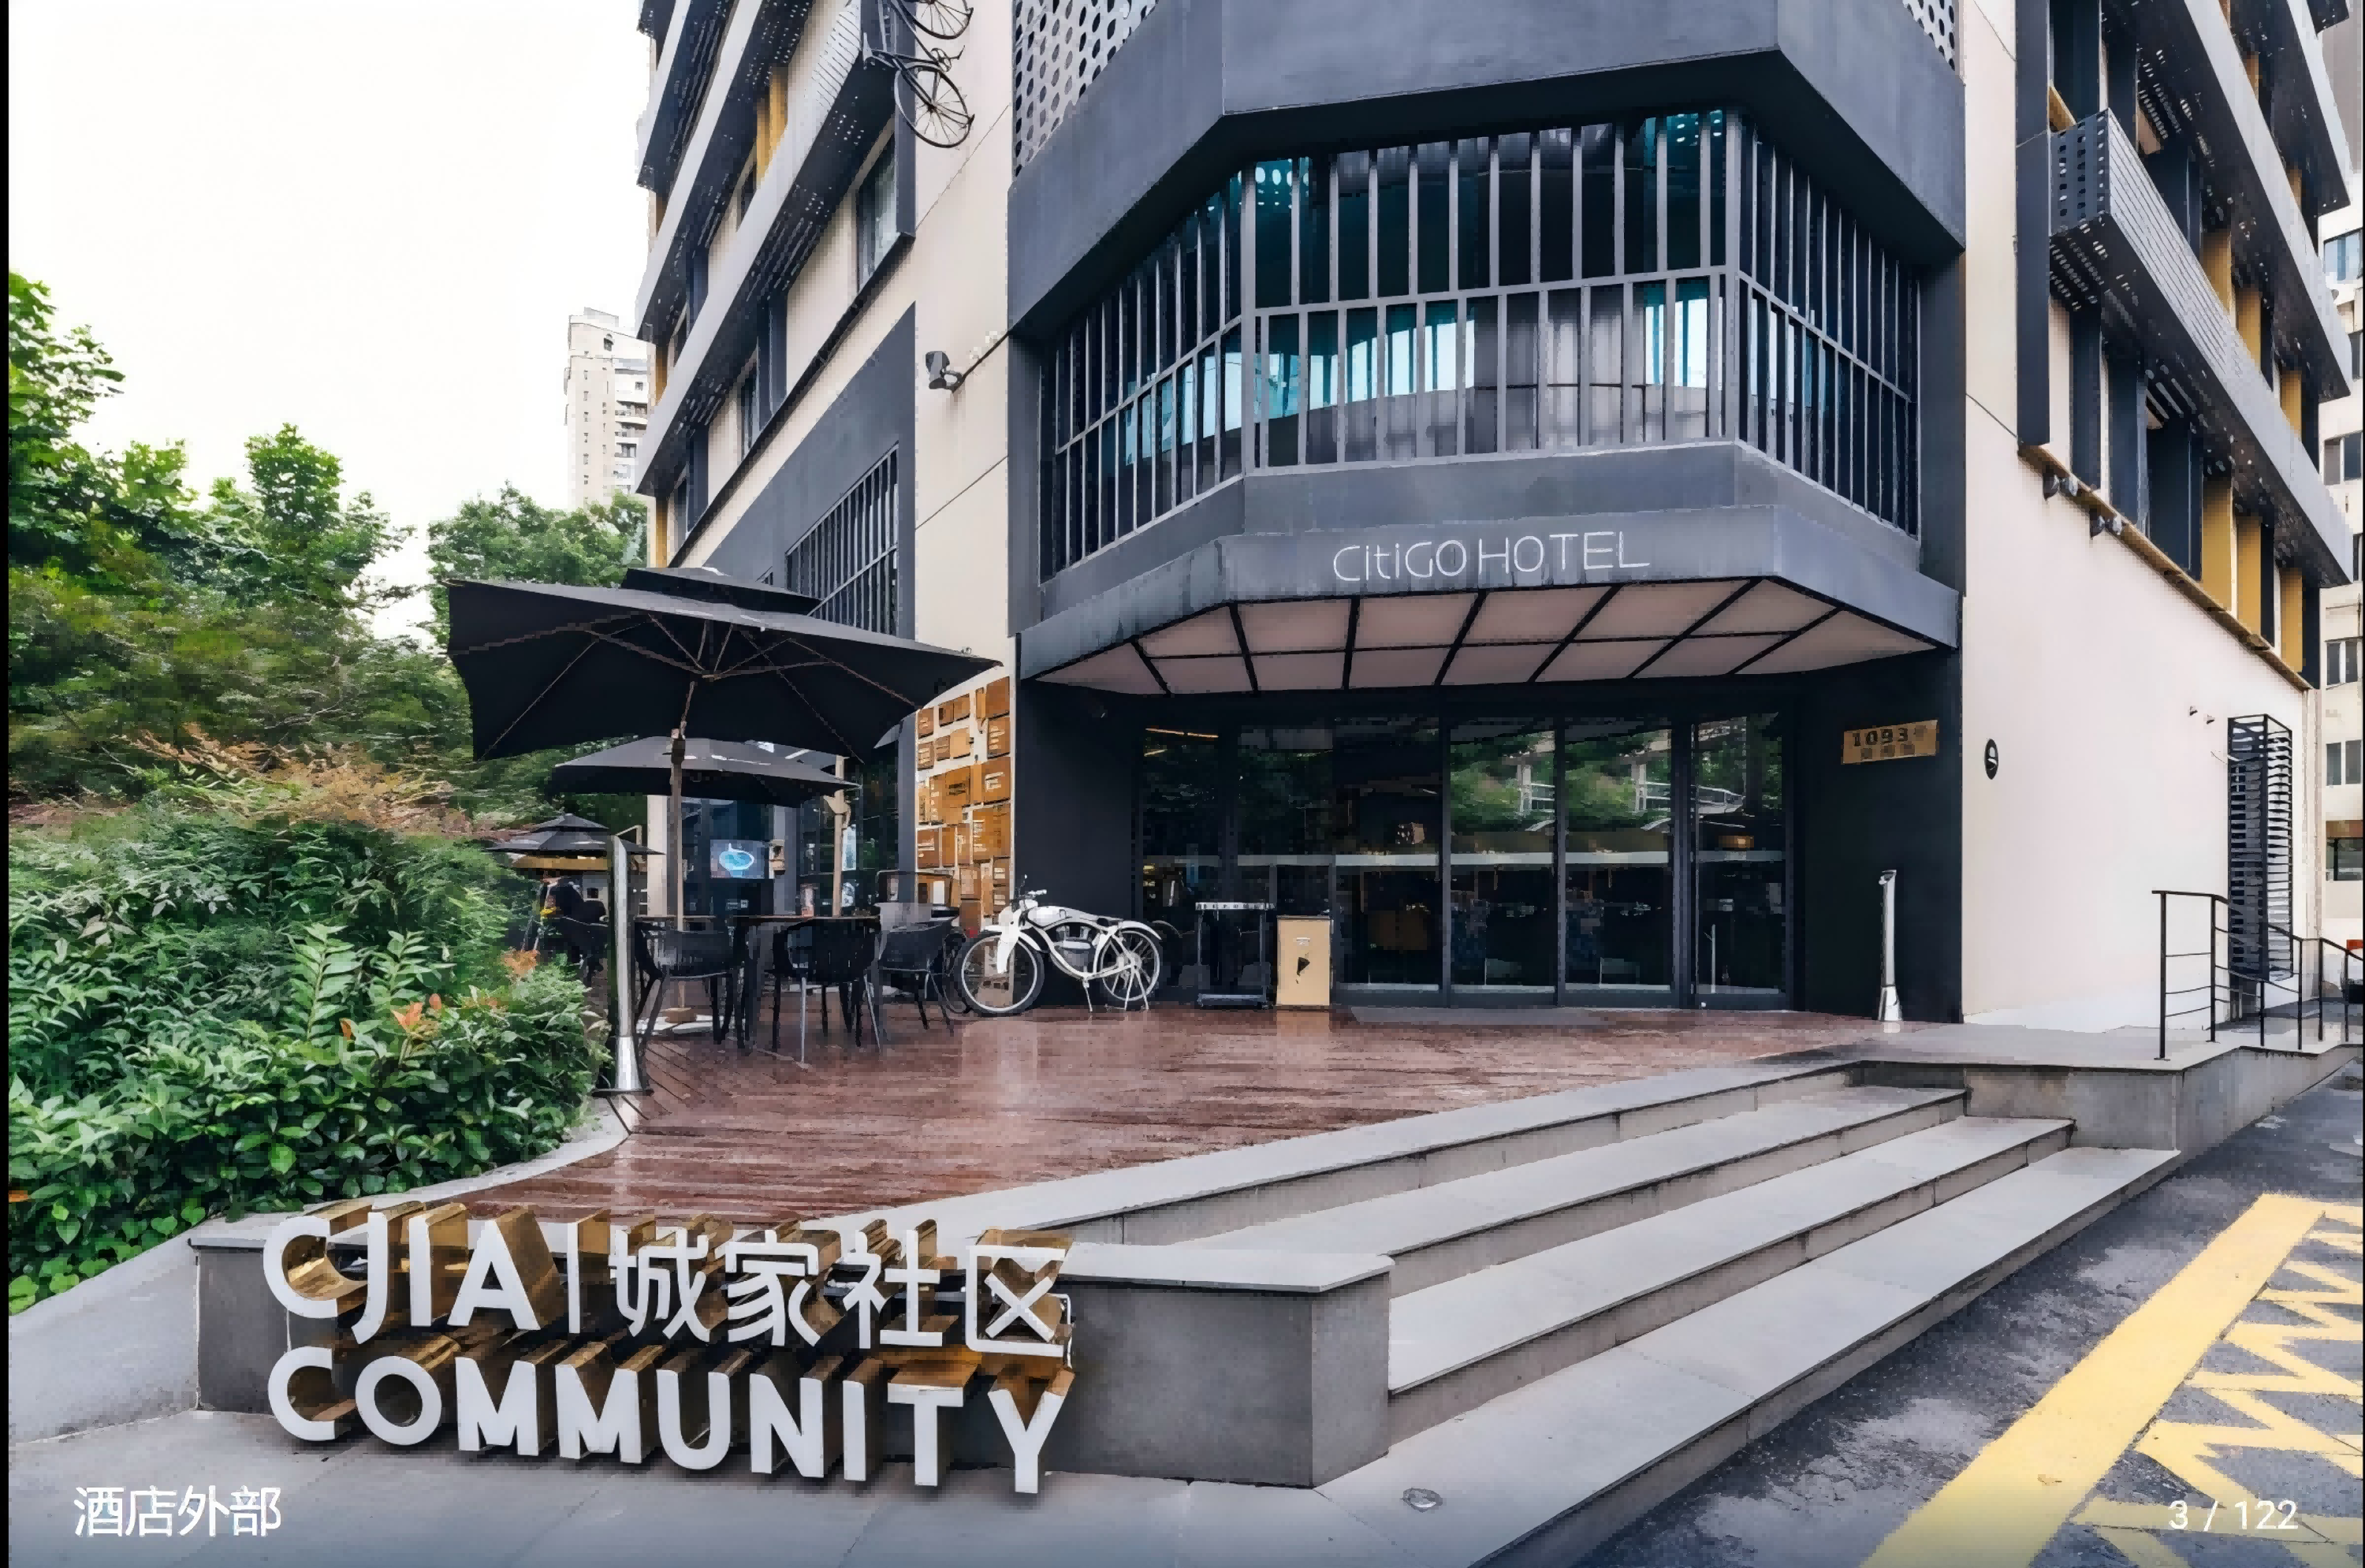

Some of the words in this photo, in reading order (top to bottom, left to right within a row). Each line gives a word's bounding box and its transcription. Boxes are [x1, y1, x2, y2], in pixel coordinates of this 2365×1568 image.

[1478, 531, 1651, 575] HOTEL
[263, 1212, 542, 1345] CJIA
[608, 1227, 1068, 1356] 城家社区
[266, 1346, 1071, 1495] COMMUNITY
